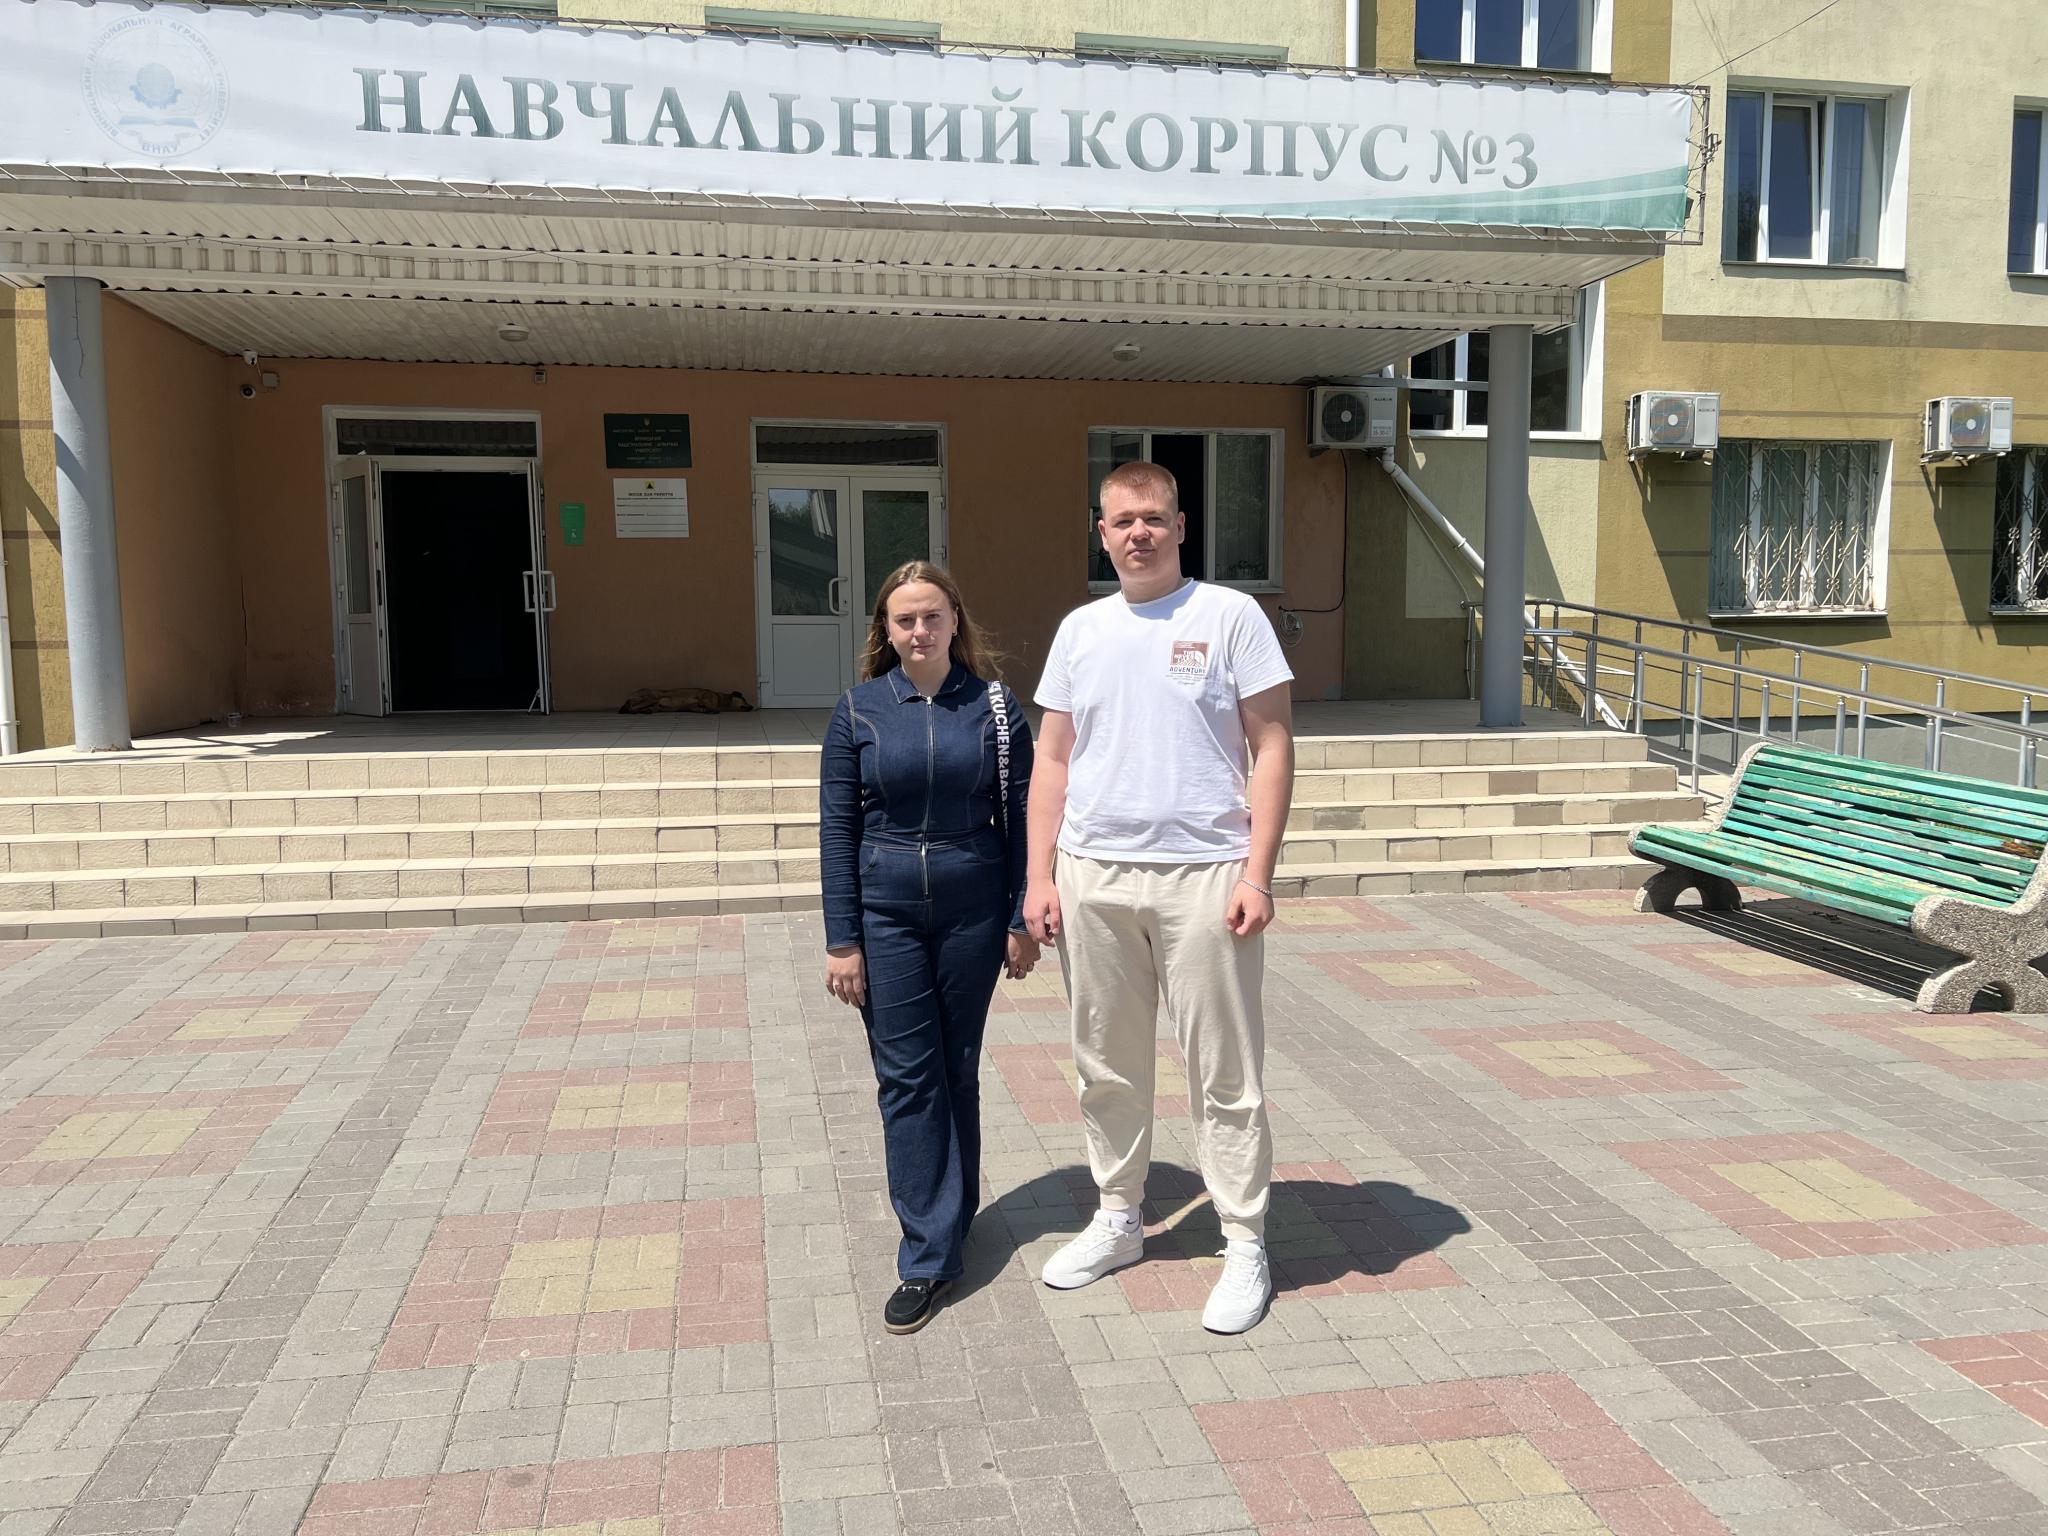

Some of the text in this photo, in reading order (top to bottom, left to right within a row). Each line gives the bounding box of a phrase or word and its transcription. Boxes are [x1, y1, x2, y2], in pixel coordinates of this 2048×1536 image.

[352, 67, 1539, 190] НАВЧАЛЬНИЙ КОРПУС №3
